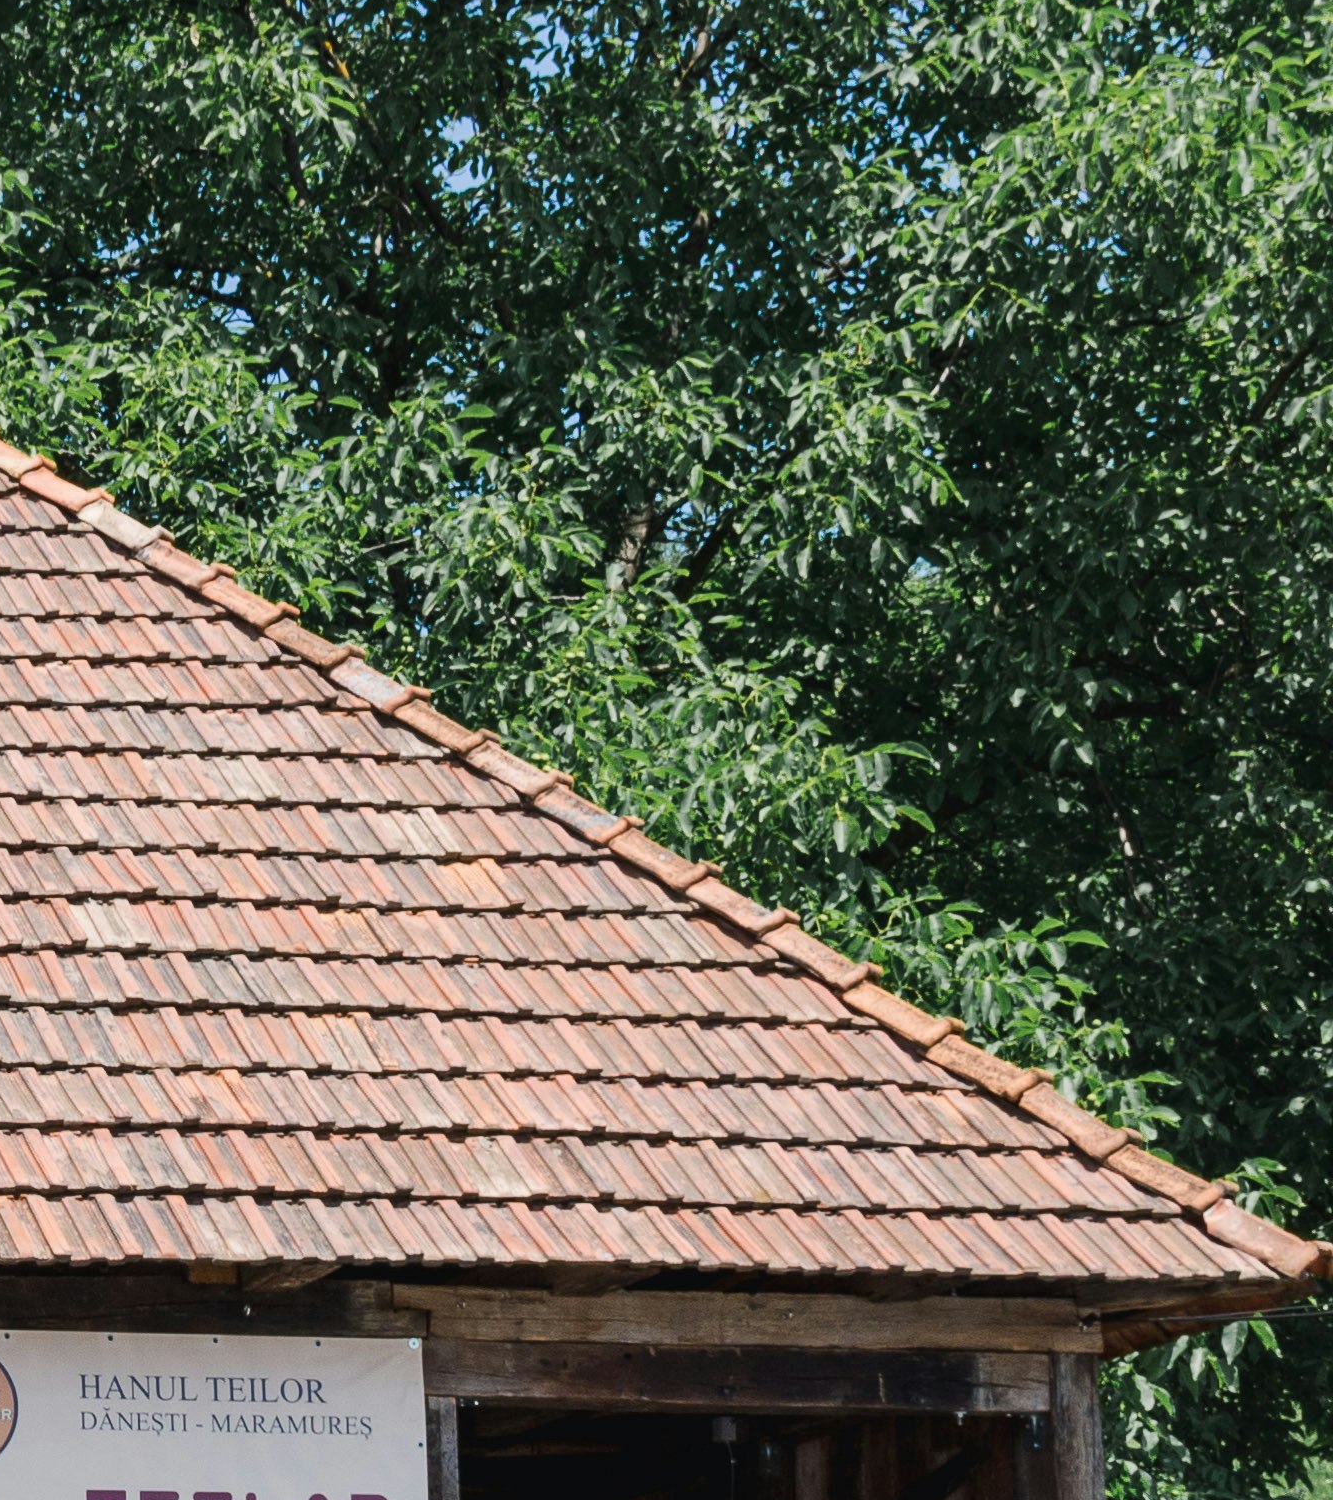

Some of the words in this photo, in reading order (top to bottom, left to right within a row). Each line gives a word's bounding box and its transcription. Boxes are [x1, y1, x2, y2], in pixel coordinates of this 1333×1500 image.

[79, 1374, 199, 1402] HANUL
[205, 1376, 327, 1405] TEILOR
[80, 1407, 188, 1435] DĂNEȘTI
[211, 1414, 373, 1441] MARAMUREȘ
